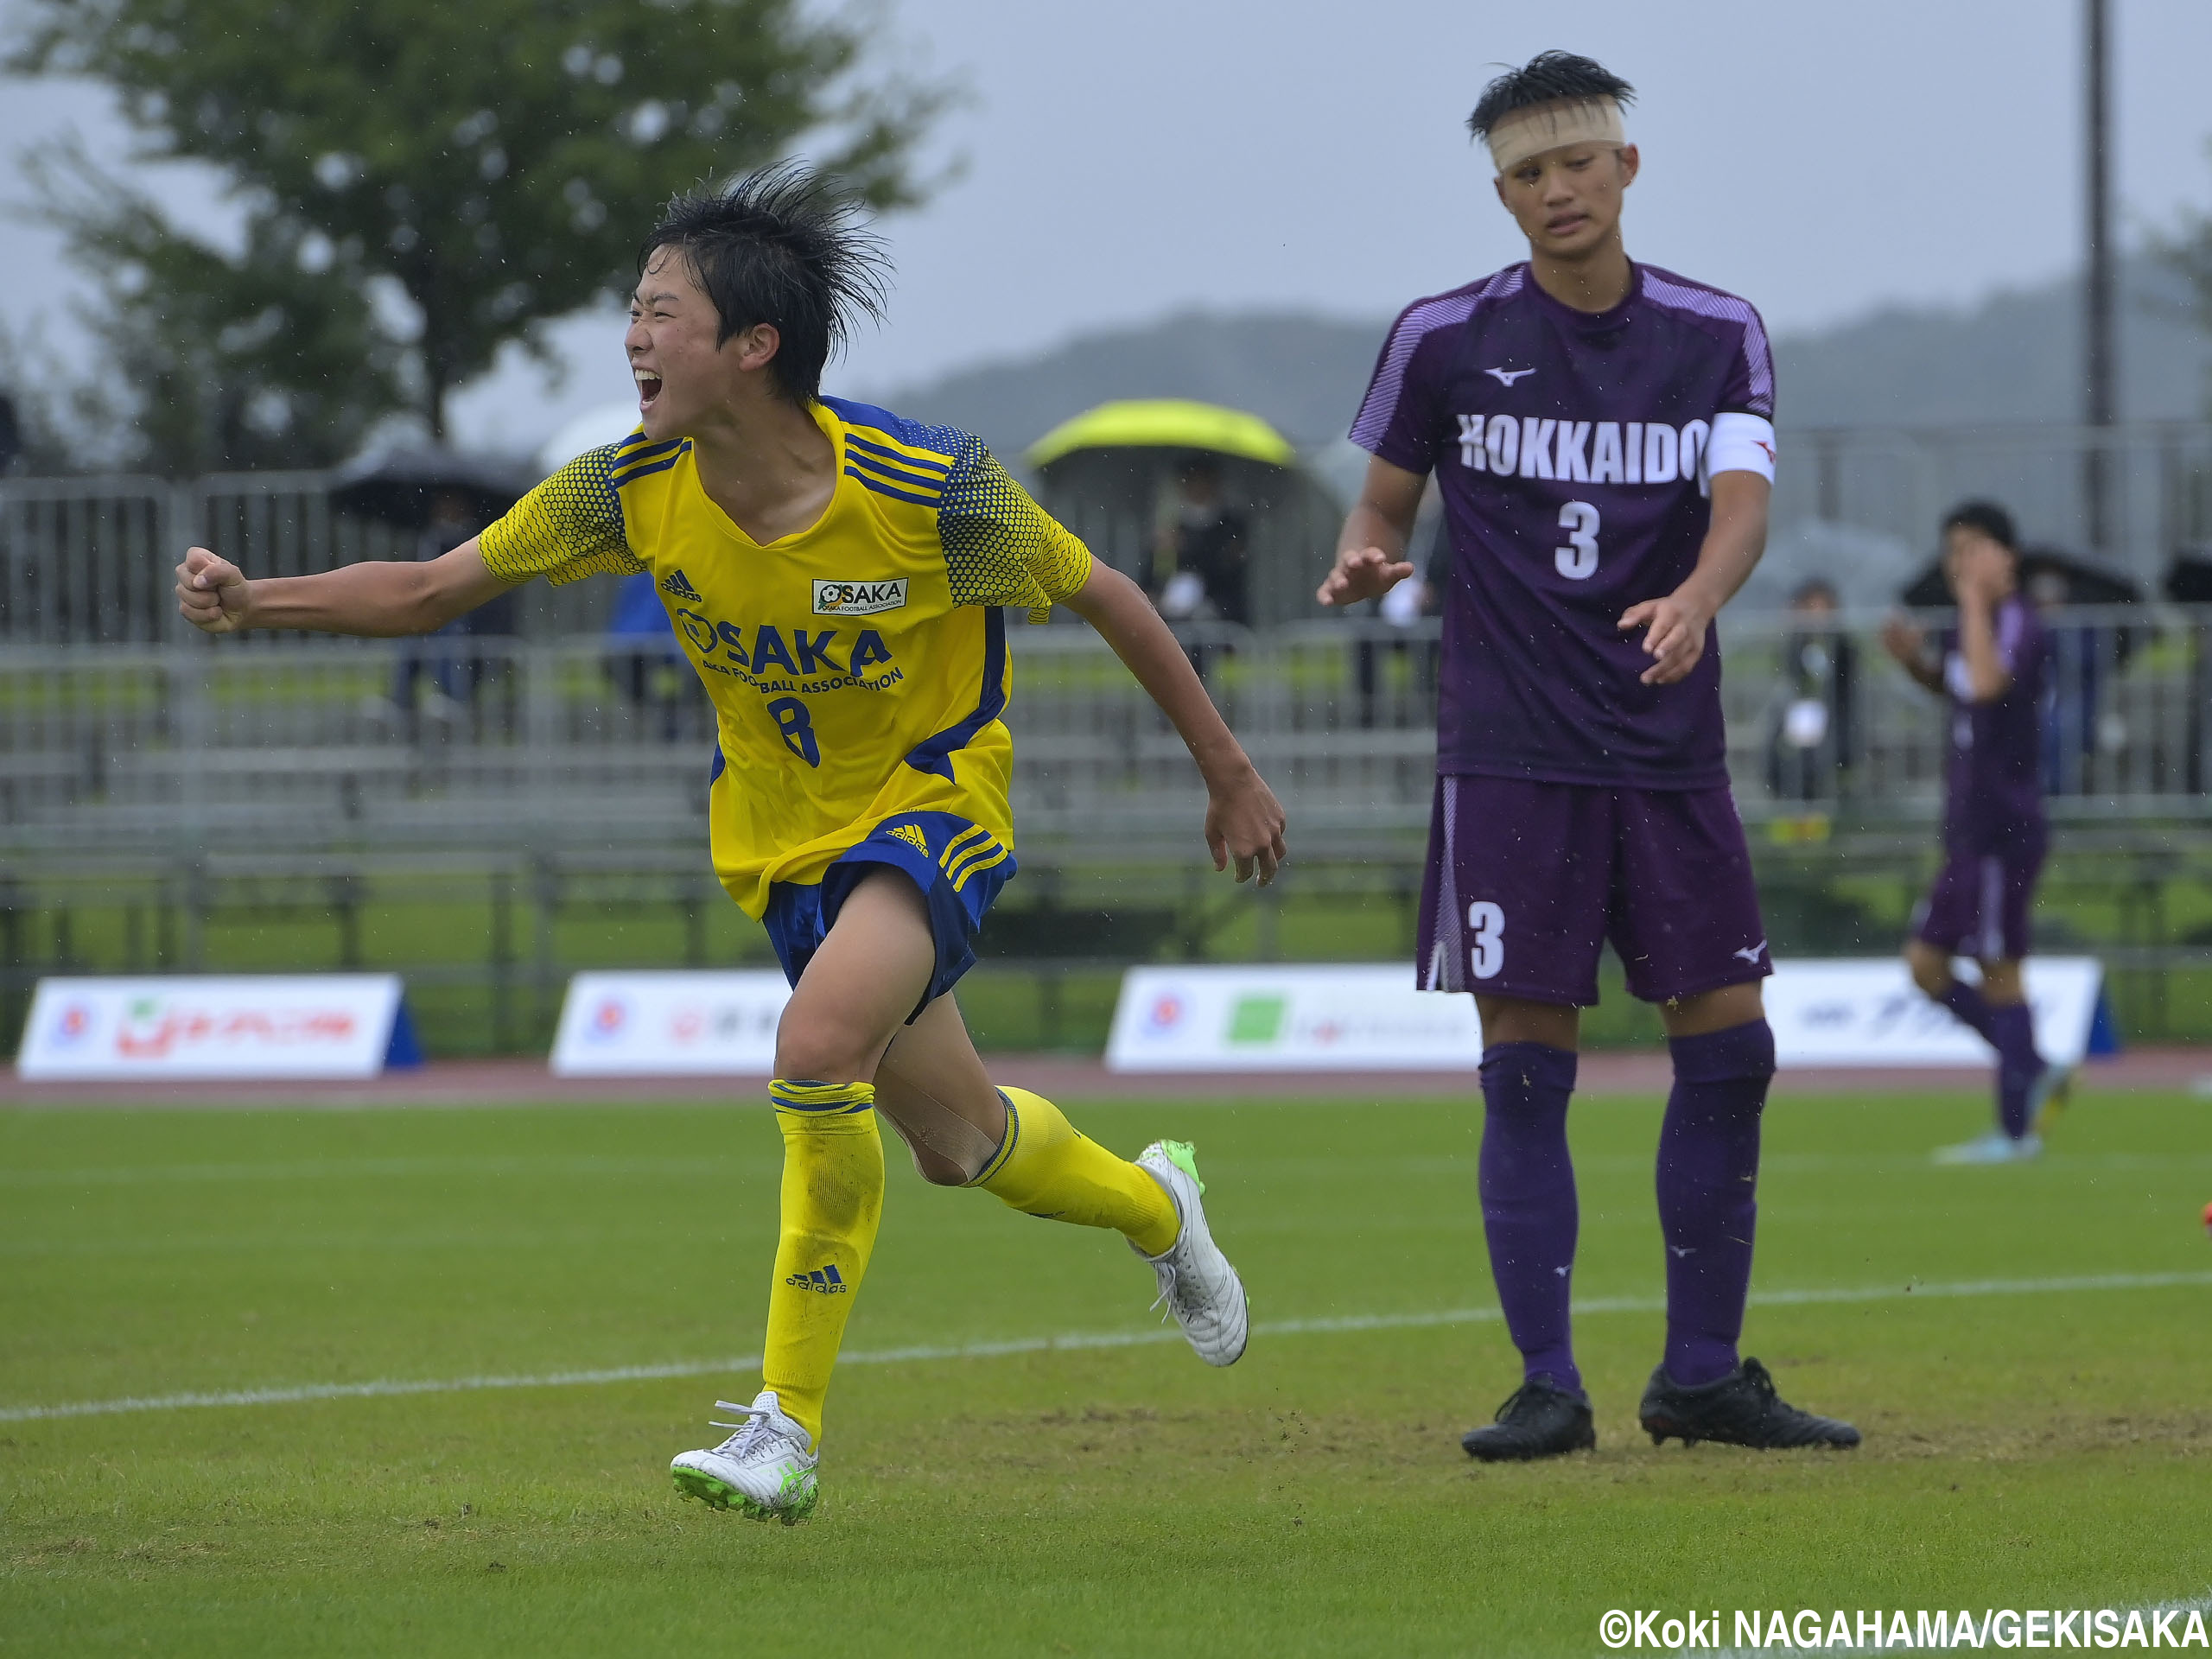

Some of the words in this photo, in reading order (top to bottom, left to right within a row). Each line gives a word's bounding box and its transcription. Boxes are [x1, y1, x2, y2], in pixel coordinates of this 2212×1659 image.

[1554, 501, 1600, 580] 3
[660, 582, 702, 603] adidas
[819, 582, 902, 604] OSAKA
[868, 599, 902, 610] ASSOCIATION
[676, 607, 893, 677] OSAKA
[801, 666, 905, 694] ASSOCIATION
[885, 830, 930, 859] adidas
[1468, 900, 1506, 979] 3
[785, 1277, 847, 1295] adidas
